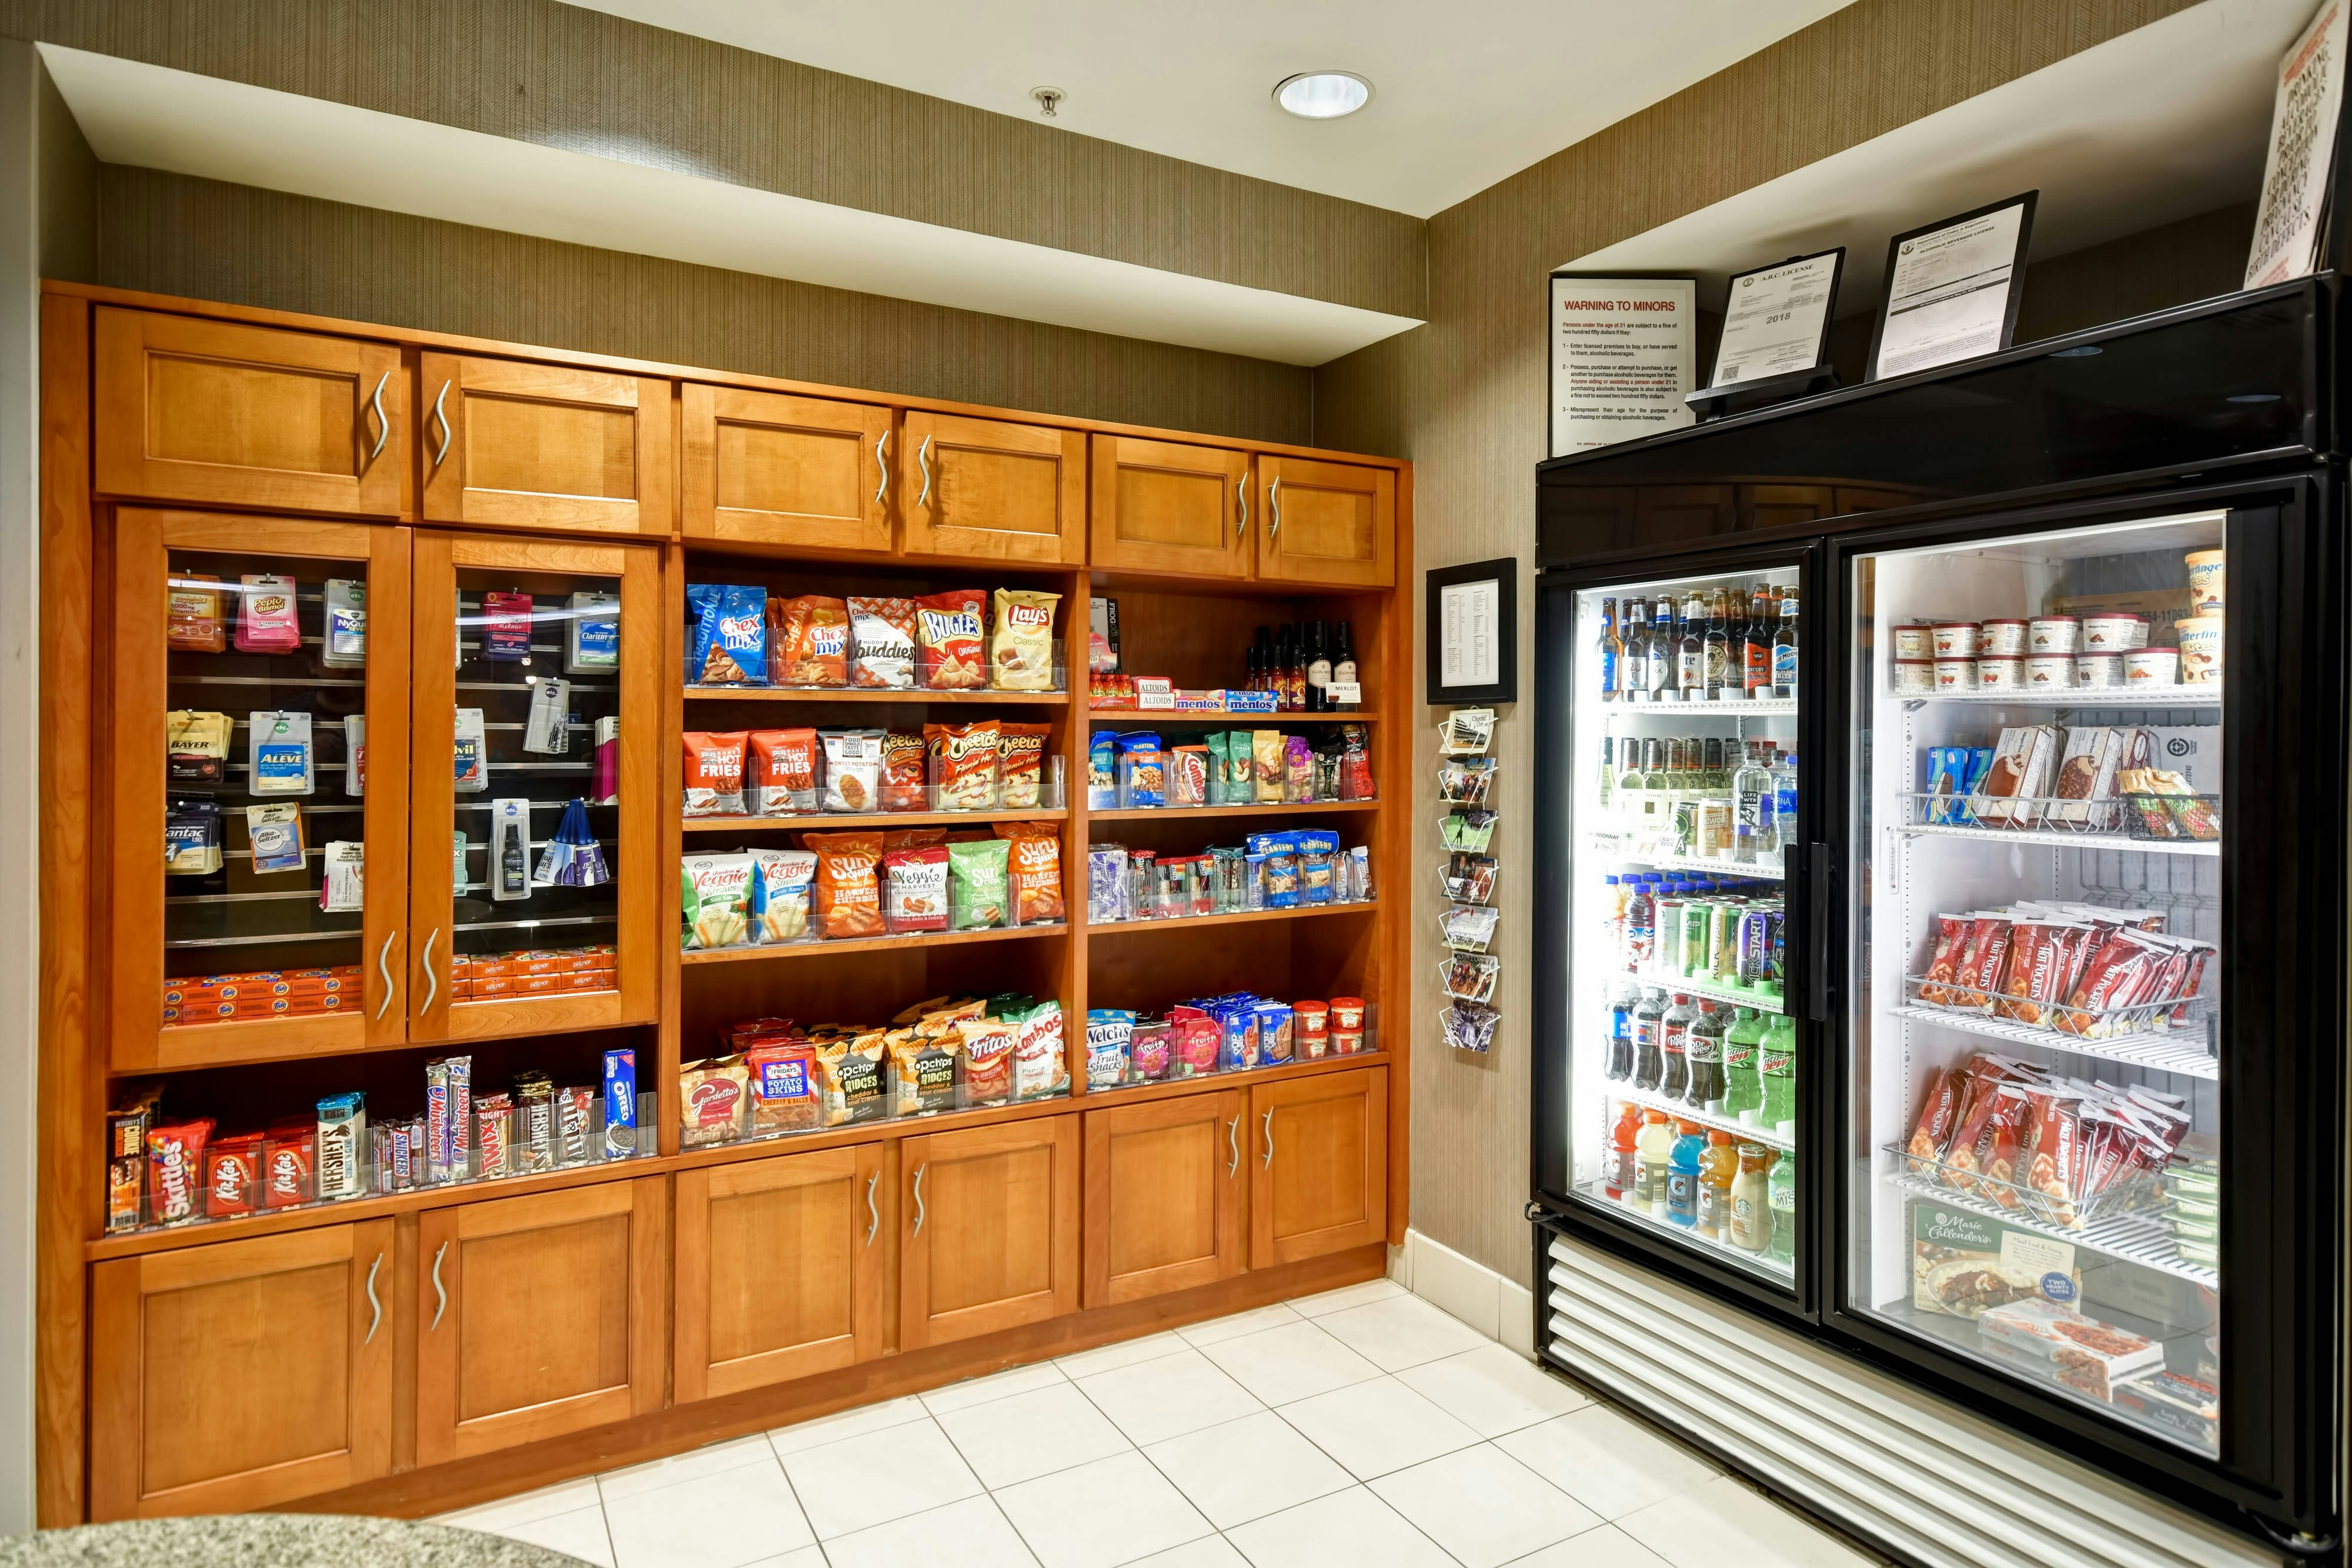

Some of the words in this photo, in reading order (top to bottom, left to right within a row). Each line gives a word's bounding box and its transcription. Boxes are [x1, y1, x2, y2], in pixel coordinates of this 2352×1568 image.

[1920, 242, 1946, 253] ALCOHOLIC
[1947, 234, 1972, 245] BEVERAGE
[1974, 226, 1994, 235] LICENSE
[1783, 265, 1813, 277] LICENSE
[1564, 300, 1613, 310] WARNING
[1616, 301, 1631, 310] TO
[1633, 302, 1675, 311] MINORS
[1766, 312, 1790, 324] 2018
[254, 597, 285, 607] Pepto-
[258, 602, 285, 612] Bismol
[338, 619, 366, 627] NyQui
[1011, 606, 1049, 626] Lay's
[695, 591, 721, 662] TRADITIONAL
[720, 614, 760, 635] Chex
[923, 611, 980, 644] BUGLES
[582, 632, 607, 640] Claritin
[726, 628, 761, 650] mix
[810, 626, 847, 641] Chex
[816, 640, 846, 656] mix
[1013, 637, 1044, 646] Classic
[853, 640, 914, 661] buddies
[1177, 700, 1220, 708] mentos
[1230, 700, 1272, 709] mentos
[949, 733, 997, 761] Cheetos
[260, 754, 302, 763] ALEVE
[718, 754, 741, 764] HOT
[788, 753, 808, 763] HOT
[700, 764, 741, 777] FRIES
[772, 762, 811, 775] FRIES
[1188, 758, 1204, 801] Combos
[166, 828, 204, 837] antac
[258, 834, 281, 843] Seltzer
[1019, 841, 1057, 865] Sun
[761, 862, 813, 881] Veggie
[692, 868, 748, 891] Veggie
[774, 877, 803, 888] Straws
[706, 884, 737, 897] Straws
[773, 888, 788, 897] Zesty
[834, 888, 878, 898] HARVEST
[834, 894, 878, 904] CHEDDAR
[1993, 941, 2004, 956] HOT
[1979, 955, 1999, 991] POCKETS
[967, 1032, 1013, 1061] Fritos
[1097, 1052, 1118, 1064] Fruit
[830, 1063, 876, 1082] popchips
[907, 1058, 953, 1074] popchips
[1090, 1060, 1121, 1073] Snacks
[845, 1076, 877, 1092] RIDGES
[921, 1070, 952, 1085] RIDGES
[430, 1087, 445, 1099] 3
[768, 1085, 803, 1094] SKINS
[847, 1090, 872, 1101] cheddar
[613, 1081, 629, 1121] OREO
[690, 1085, 739, 1117] Gardetto's
[847, 1097, 860, 1106] sour
[861, 1095, 880, 1103] cream
[452, 1086, 470, 1151] Musketeers
[479, 1110, 505, 1119] RIGHT
[428, 1099, 447, 1164] Musketeers
[394, 1133, 410, 1176] SNICKERS
[480, 1121, 500, 1175] TWIX
[160, 1140, 191, 1217] Skittles
[1945, 1216, 1982, 1231] Marie
[1929, 1225, 1992, 1243] Callender's
